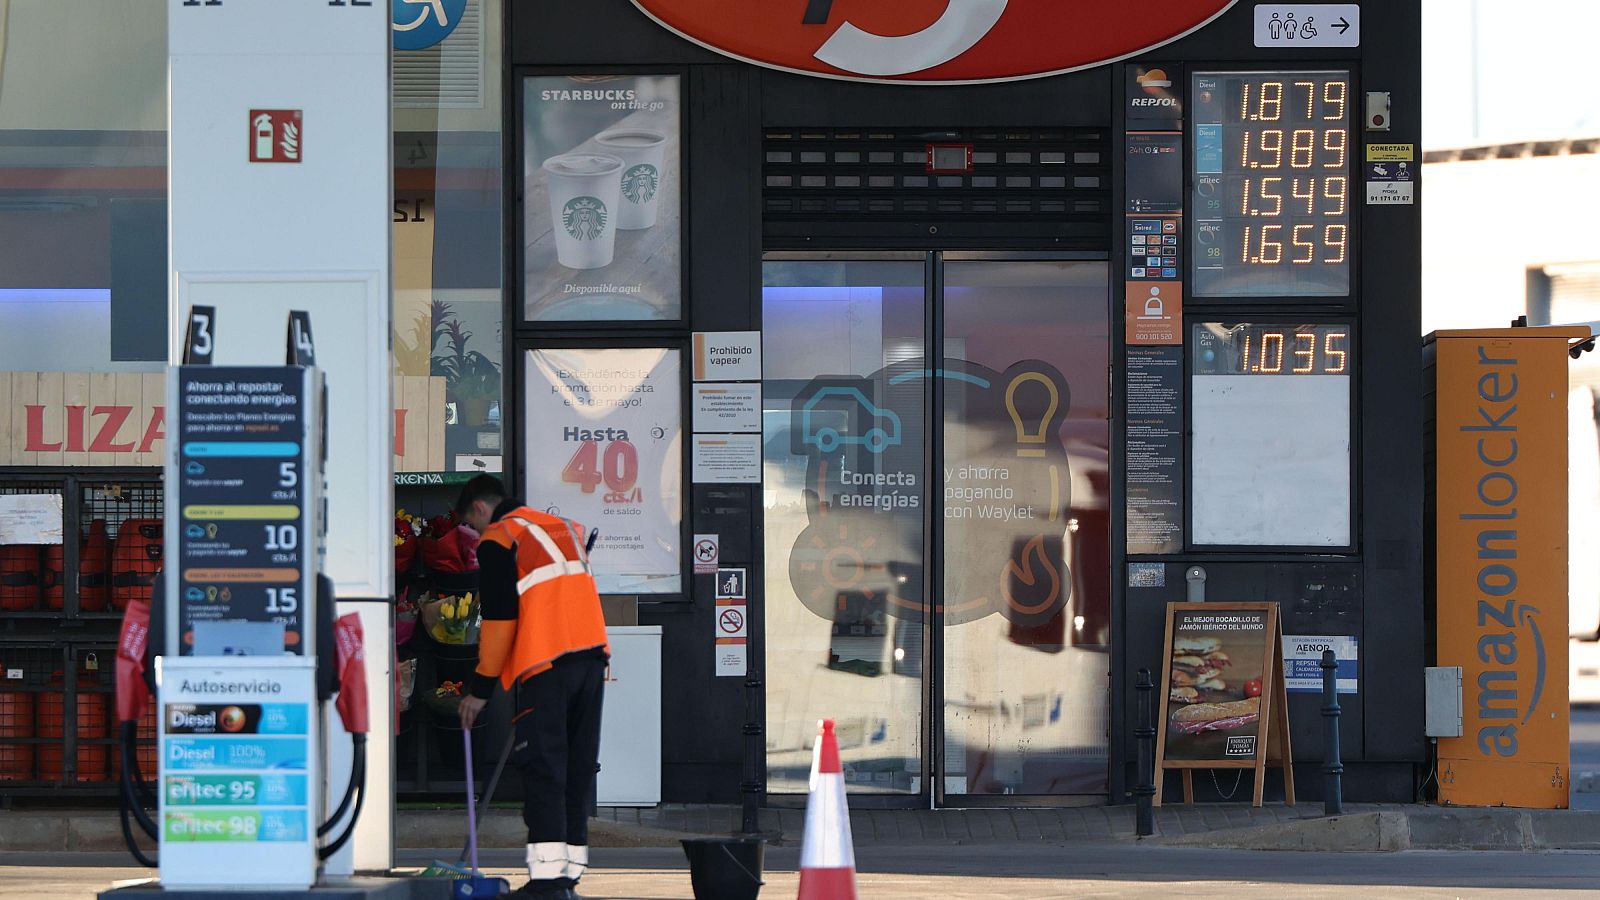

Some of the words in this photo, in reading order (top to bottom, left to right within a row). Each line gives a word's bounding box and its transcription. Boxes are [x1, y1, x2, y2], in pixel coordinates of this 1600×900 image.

[542, 90, 634, 101] STARBUCKS
[1132, 98, 1176, 106] REPSOL
[1241, 82, 1346, 121] 1.879
[611, 102, 626, 110] on
[628, 100, 647, 110] the
[649, 103, 664, 111] go
[1241, 129, 1346, 168] 1.989
[1241, 177, 1346, 216] 1.549
[1208, 200, 1220, 209] 95
[1241, 225, 1346, 263] 1.659
[1208, 248, 1220, 256] 98
[564, 283, 617, 294] Disponible
[619, 283, 641, 294] aquí
[193, 314, 212, 355] 3
[295, 318, 312, 357] 4
[711, 347, 752, 355] Prohibido
[1242, 333, 1346, 372] 1.035
[711, 357, 741, 366] vapear
[187, 382, 223, 392] Ahorra
[225, 382, 236, 392] al
[239, 383, 283, 394] repostar
[552, 383, 616, 394] promoción
[621, 383, 655, 393] hasta
[187, 394, 249, 405] conectando
[607, 397, 643, 409] mayo!
[564, 427, 630, 442] Hasta
[280, 462, 298, 487] 5
[561, 440, 638, 494] 40
[959, 465, 1009, 480] ahorra
[841, 471, 917, 486] Conecta
[841, 489, 920, 511] energías
[945, 485, 1014, 502] pagando
[604, 507, 616, 515] de
[617, 507, 642, 515] saldo
[945, 505, 973, 519] con
[979, 504, 1034, 522] Waylet
[264, 525, 298, 550] 10
[606, 542, 645, 551] repostajes
[1459, 345, 1518, 757] amazonlocker
[266, 588, 298, 613] 15
[1296, 644, 1330, 652] AENOR
[181, 679, 281, 694] Autoservicio
[171, 710, 216, 728] Diesel
[171, 744, 216, 760] Diesel
[171, 781, 227, 799] efitec
[228, 780, 256, 800] 95
[228, 815, 257, 835] 98
